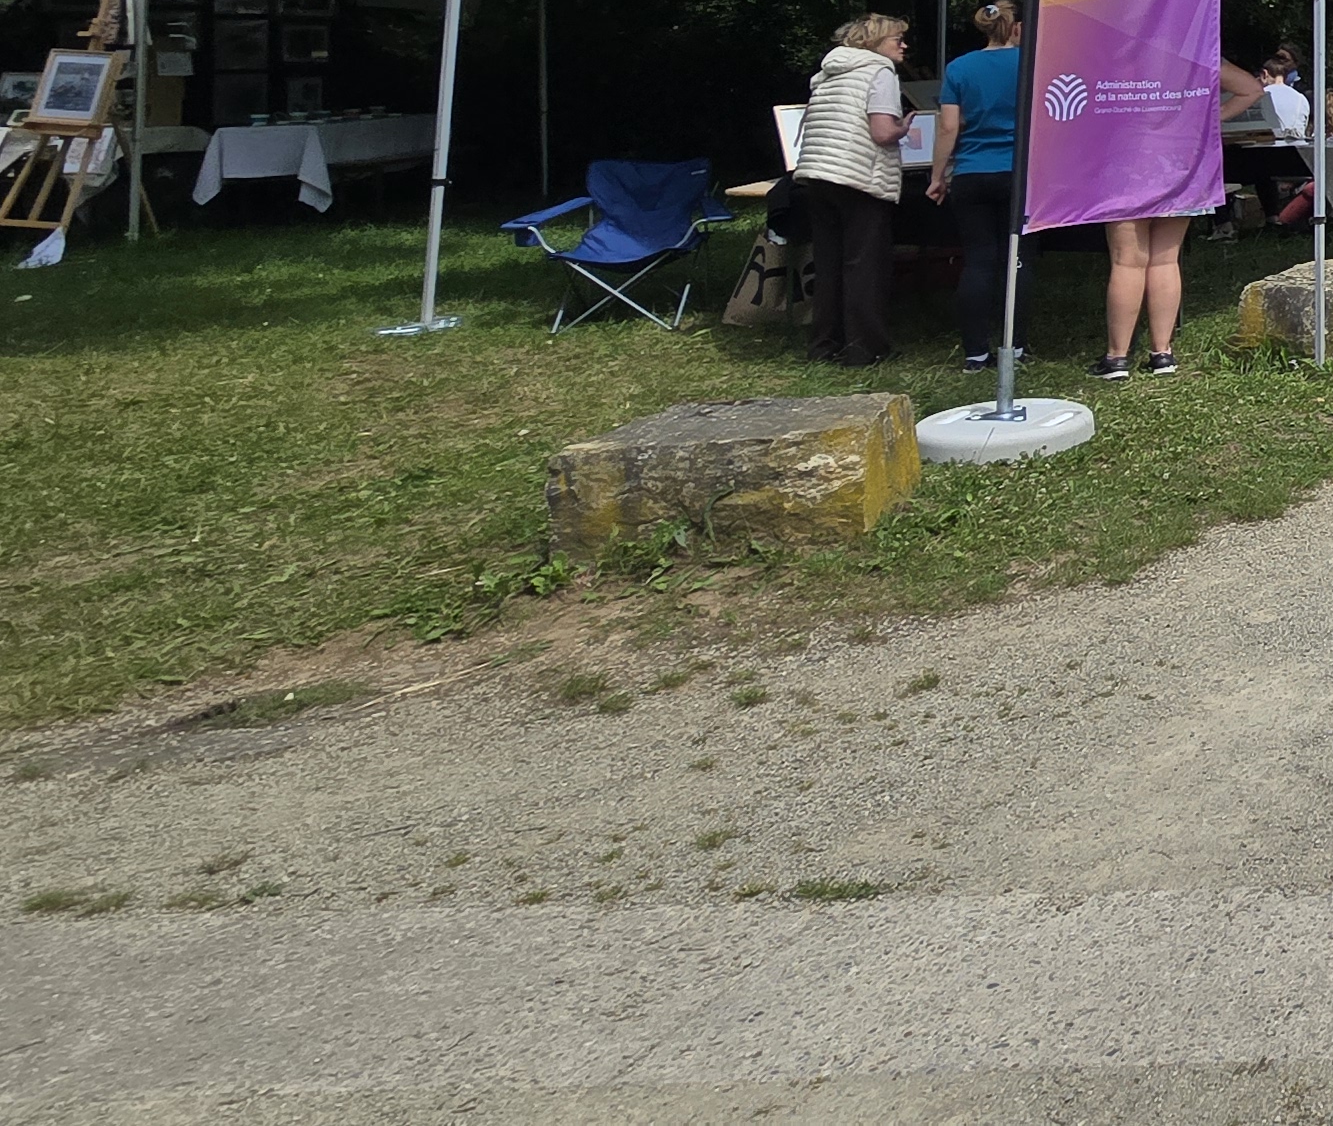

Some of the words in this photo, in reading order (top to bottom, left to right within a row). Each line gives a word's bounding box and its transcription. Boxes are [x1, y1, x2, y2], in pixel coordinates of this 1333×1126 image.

[1095, 80, 1161, 89] Administration
[1095, 92, 1106, 102] de
[1108, 92, 1116, 101] la
[1117, 92, 1147, 101] nature
[1149, 90, 1160, 100] et
[1162, 89, 1181, 100] des
[1183, 87, 1210, 97] forêts
